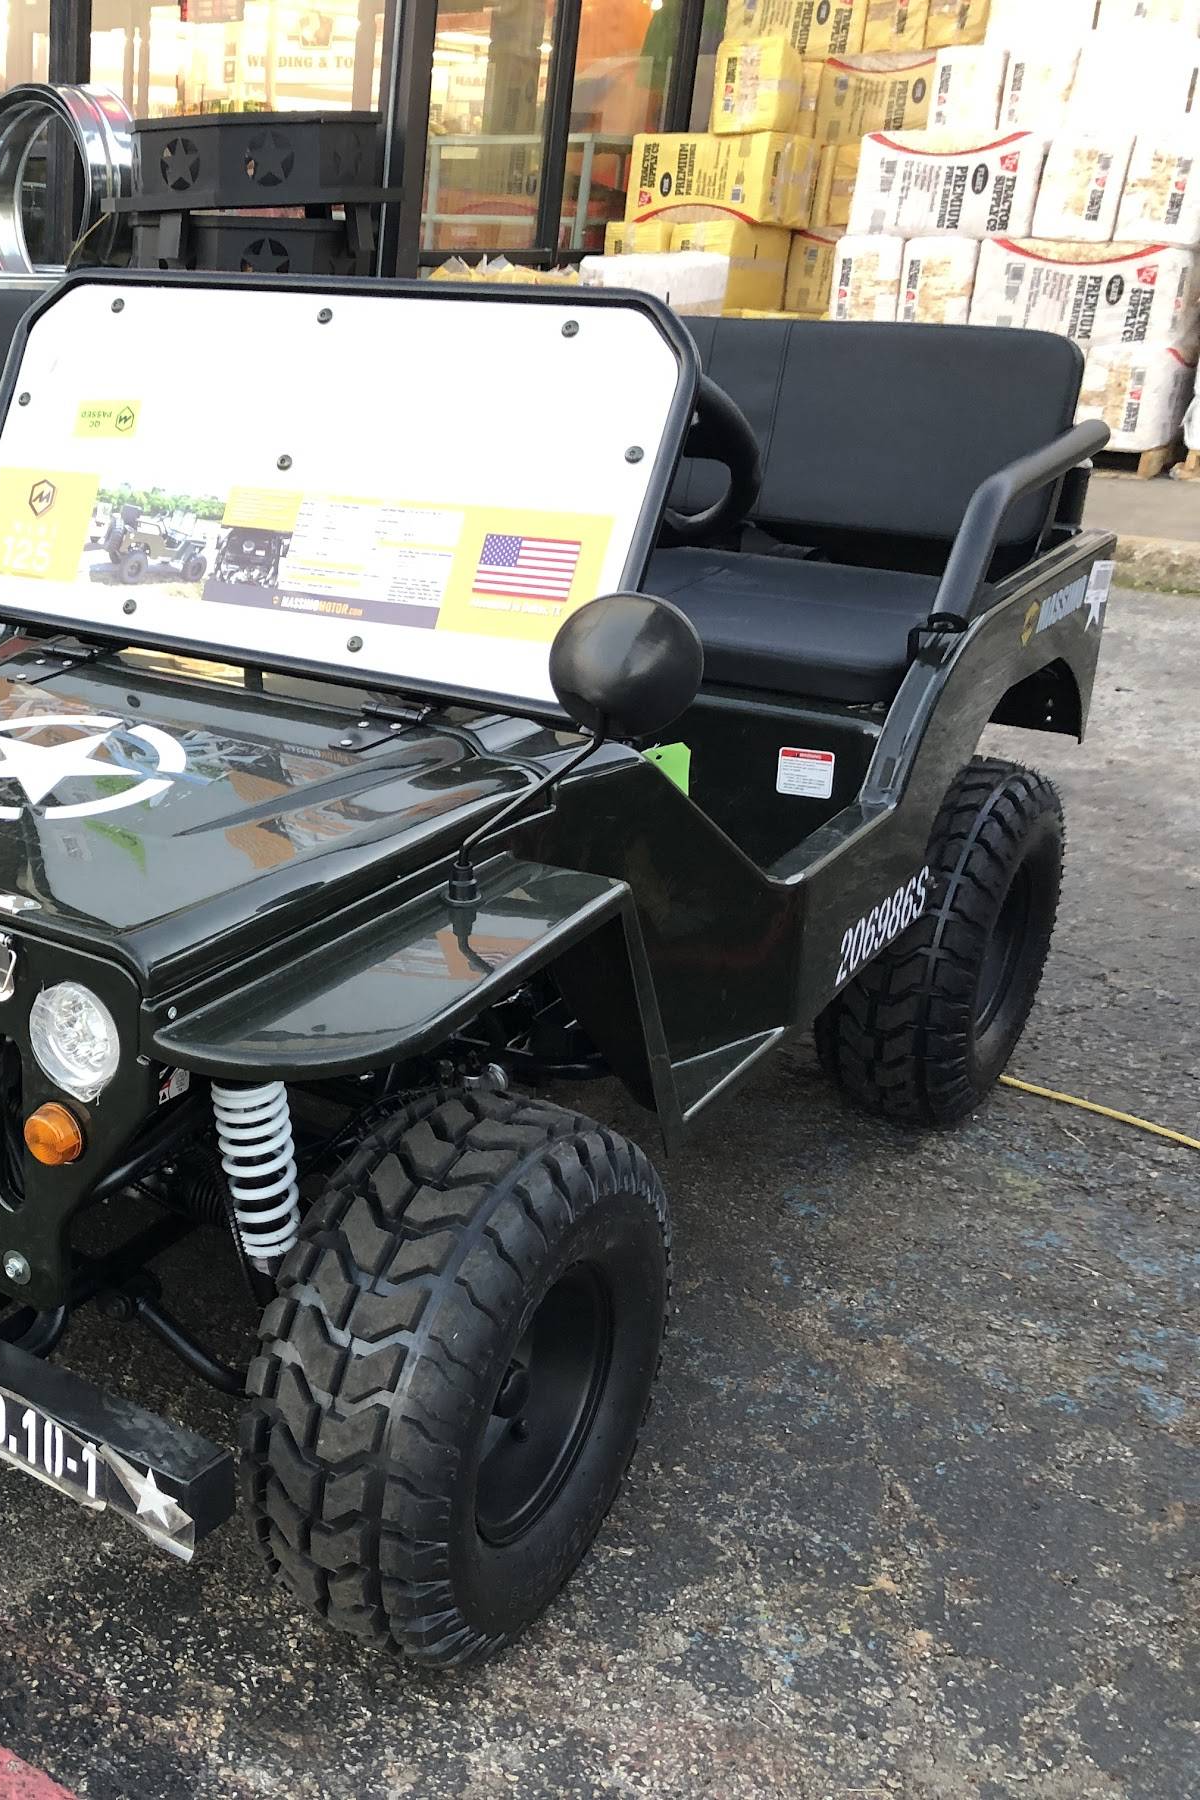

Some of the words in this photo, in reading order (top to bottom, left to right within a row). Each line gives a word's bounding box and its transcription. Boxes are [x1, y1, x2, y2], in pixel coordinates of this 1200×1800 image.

[798, 1, 814, 54] PREMIUM
[247, 55, 312, 68] WEDING
[640, 143, 652, 188] TRACTOR
[648, 154, 658, 188] SUPPLY
[675, 143, 689, 196] PREMIUM
[943, 166, 955, 186] PINE
[936, 187, 950, 229] SHAVINGS
[946, 166, 968, 230] PREMIUM
[989, 175, 1006, 217] SUPPLY
[997, 176, 1017, 231] TRACTOR
[1075, 275, 1087, 295] PINE
[1067, 297, 1083, 338] SHAVINGS
[1078, 275, 1103, 340] PREMIUM
[1124, 288, 1142, 327] SUPPLY
[1133, 289, 1154, 342] TRACTOR
[80, 410, 113, 419] PASSED
